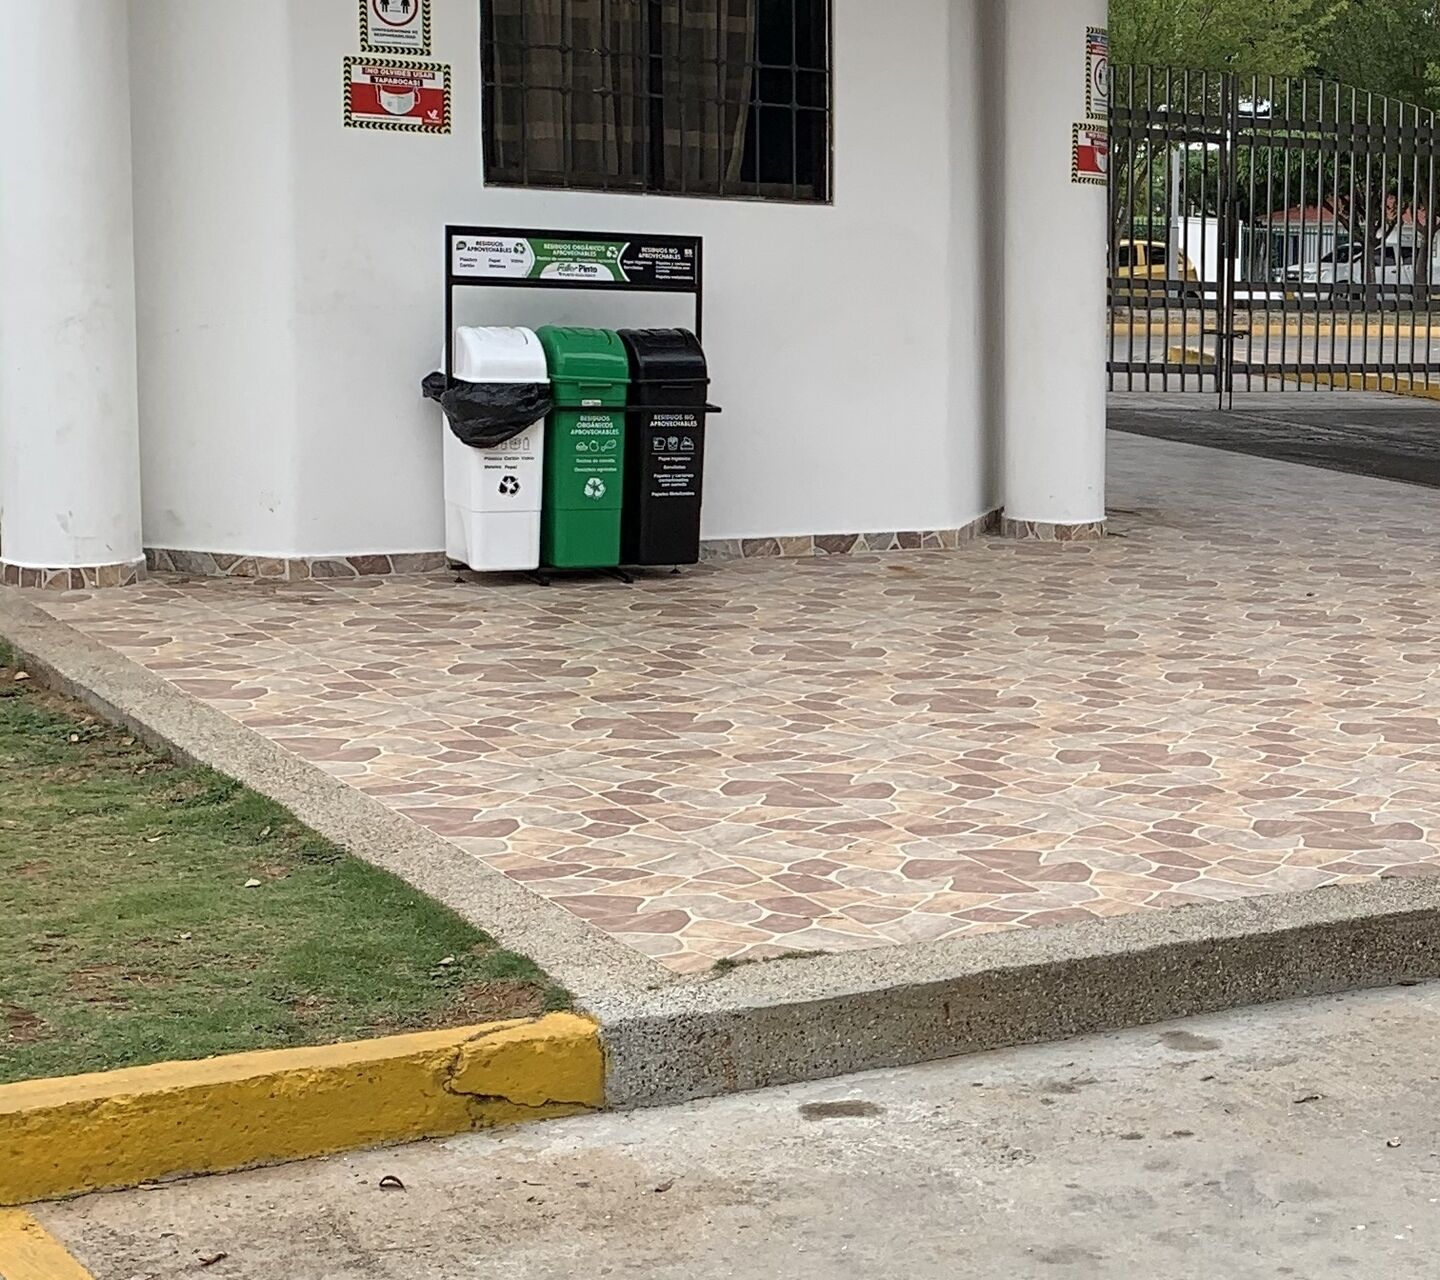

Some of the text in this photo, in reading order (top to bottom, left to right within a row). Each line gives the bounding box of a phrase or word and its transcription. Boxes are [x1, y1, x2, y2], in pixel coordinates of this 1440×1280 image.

[412, 71, 433, 79] USAR
[467, 246, 512, 254] APROVECHABLES
[578, 264, 598, 273] Pinto
[576, 421, 614, 429] ORGÁNICOS
[570, 428, 620, 436] APROVECHABLES
